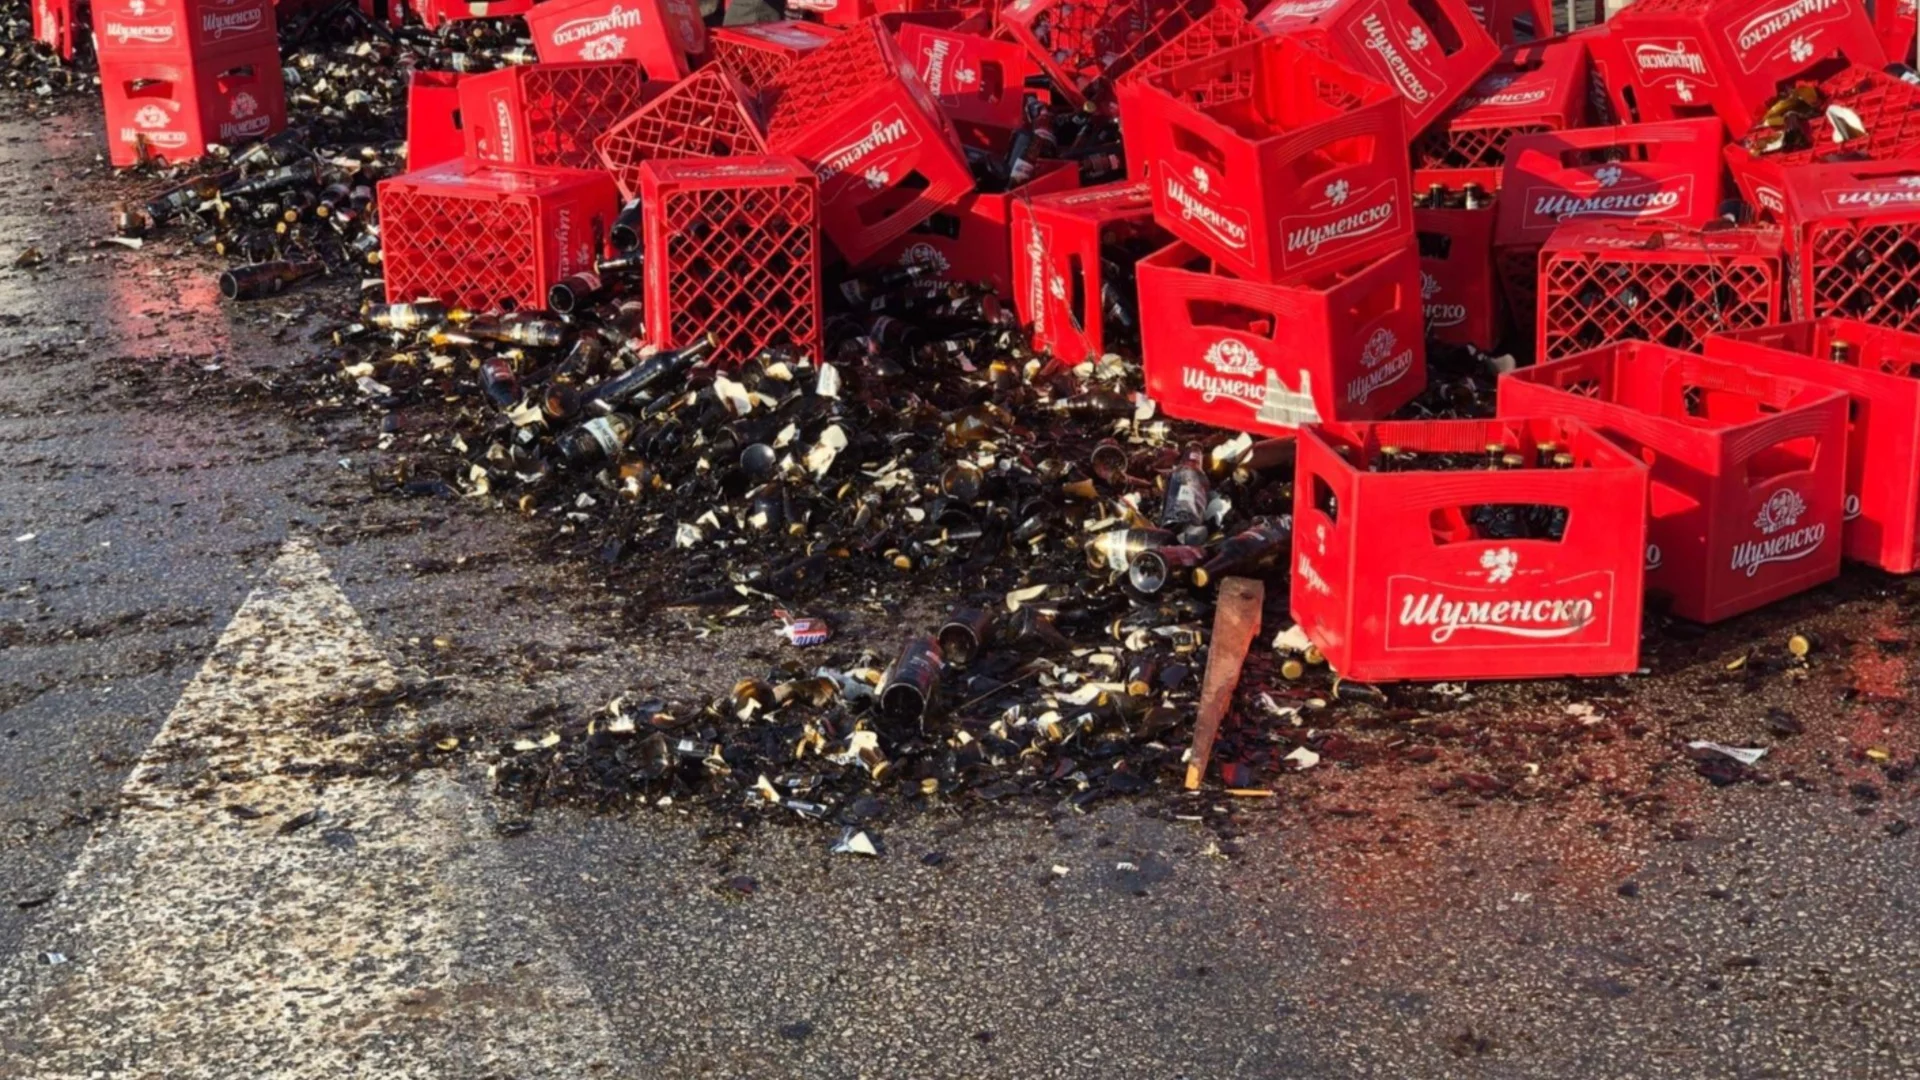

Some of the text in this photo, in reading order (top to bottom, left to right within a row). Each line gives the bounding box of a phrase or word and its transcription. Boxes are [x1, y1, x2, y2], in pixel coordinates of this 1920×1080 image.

[107, 23, 173, 43] Шуменско
[203, 7, 261, 34] Шуменско
[553, 6, 640, 46] Шуменско
[1362, 13, 1428, 103] Шуменско
[1636, 42, 1705, 74] Шуменско
[1167, 177, 1246, 249] Шуменско
[1287, 201, 1393, 255] Шуменско
[1535, 190, 1678, 223] Шуменско
[554, 209, 570, 281] Шумен
[1183, 366, 1267, 409] Шуменс
[1347, 348, 1412, 405] Шуменско
[1731, 522, 1825, 577] Шуменско
[1400, 594, 1596, 644] Шуменско
